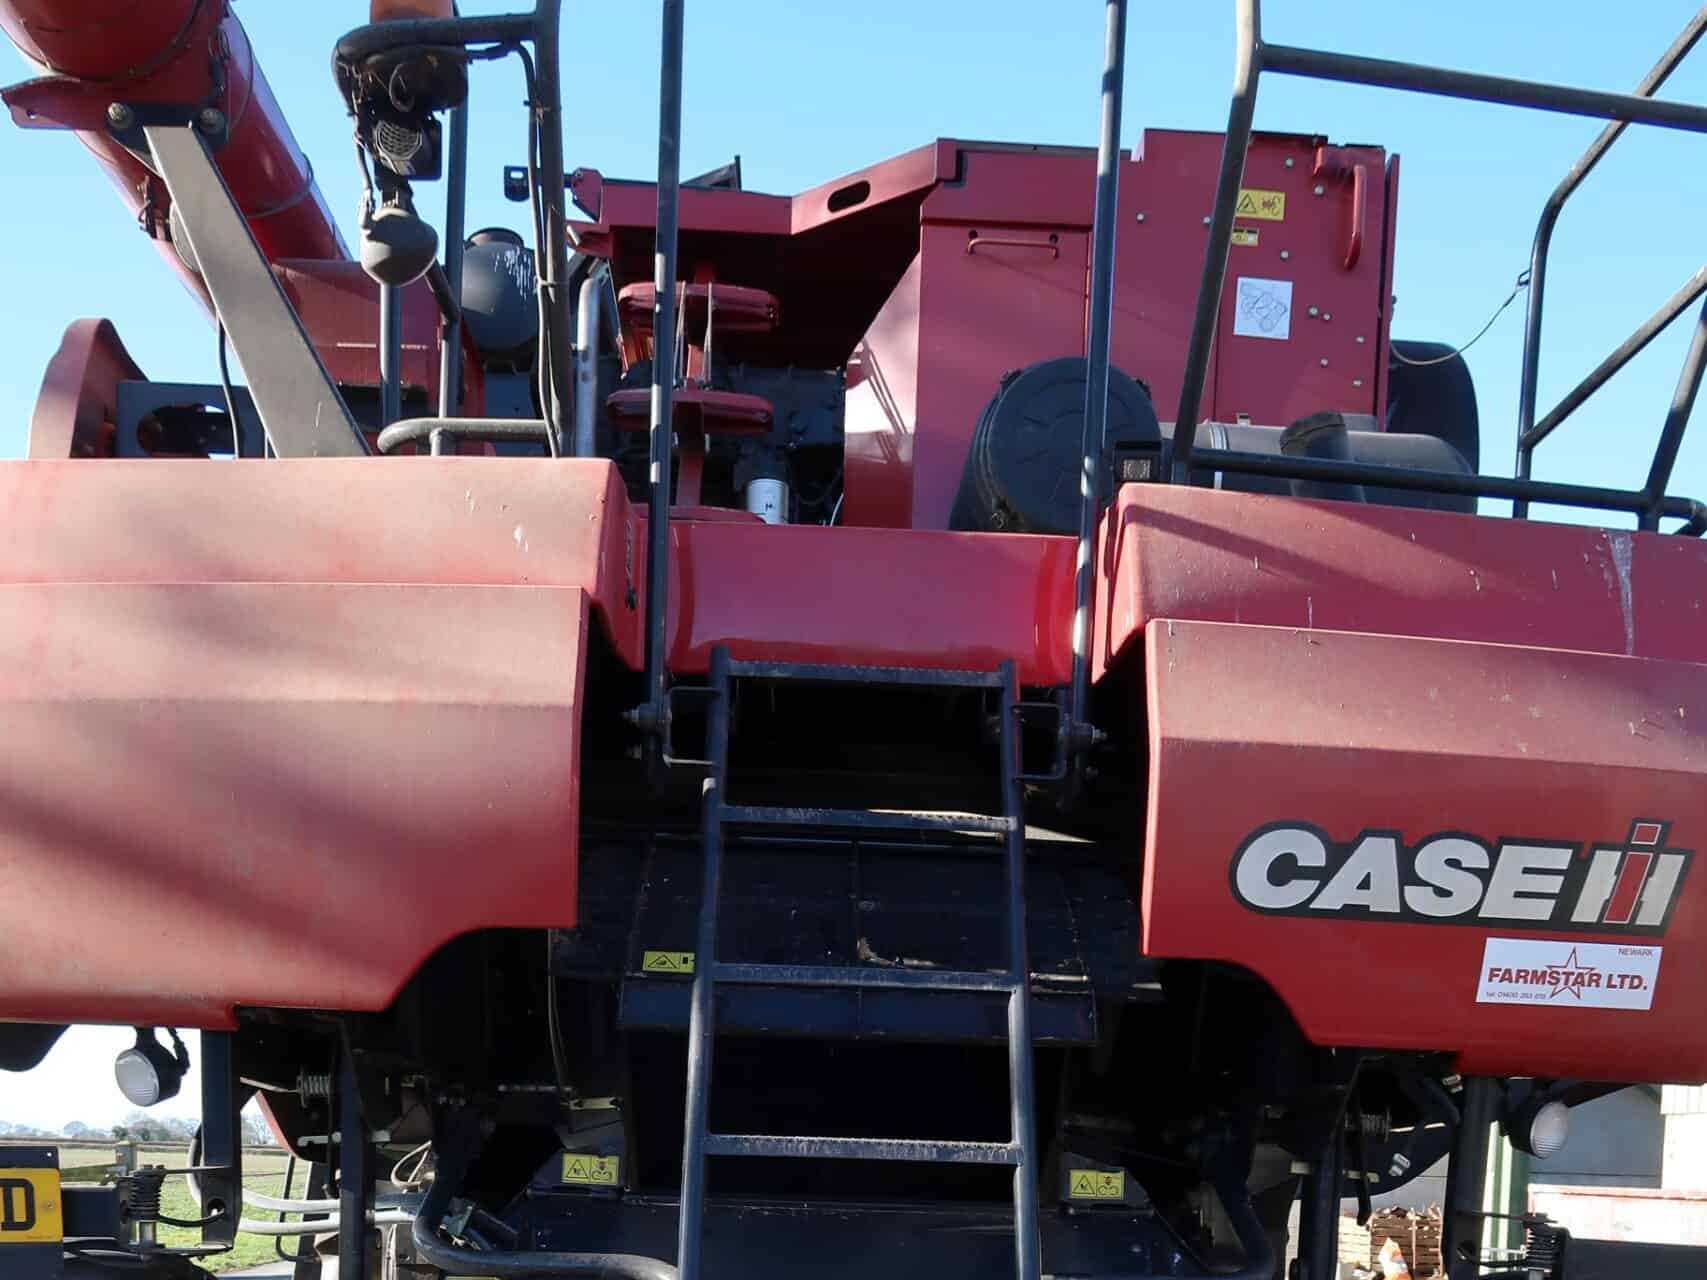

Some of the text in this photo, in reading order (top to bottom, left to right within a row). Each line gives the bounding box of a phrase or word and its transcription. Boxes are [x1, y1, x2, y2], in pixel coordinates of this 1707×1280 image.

[1236, 828, 1573, 921] CASE
[1487, 967, 1648, 990] FARMSTAR LTD.
